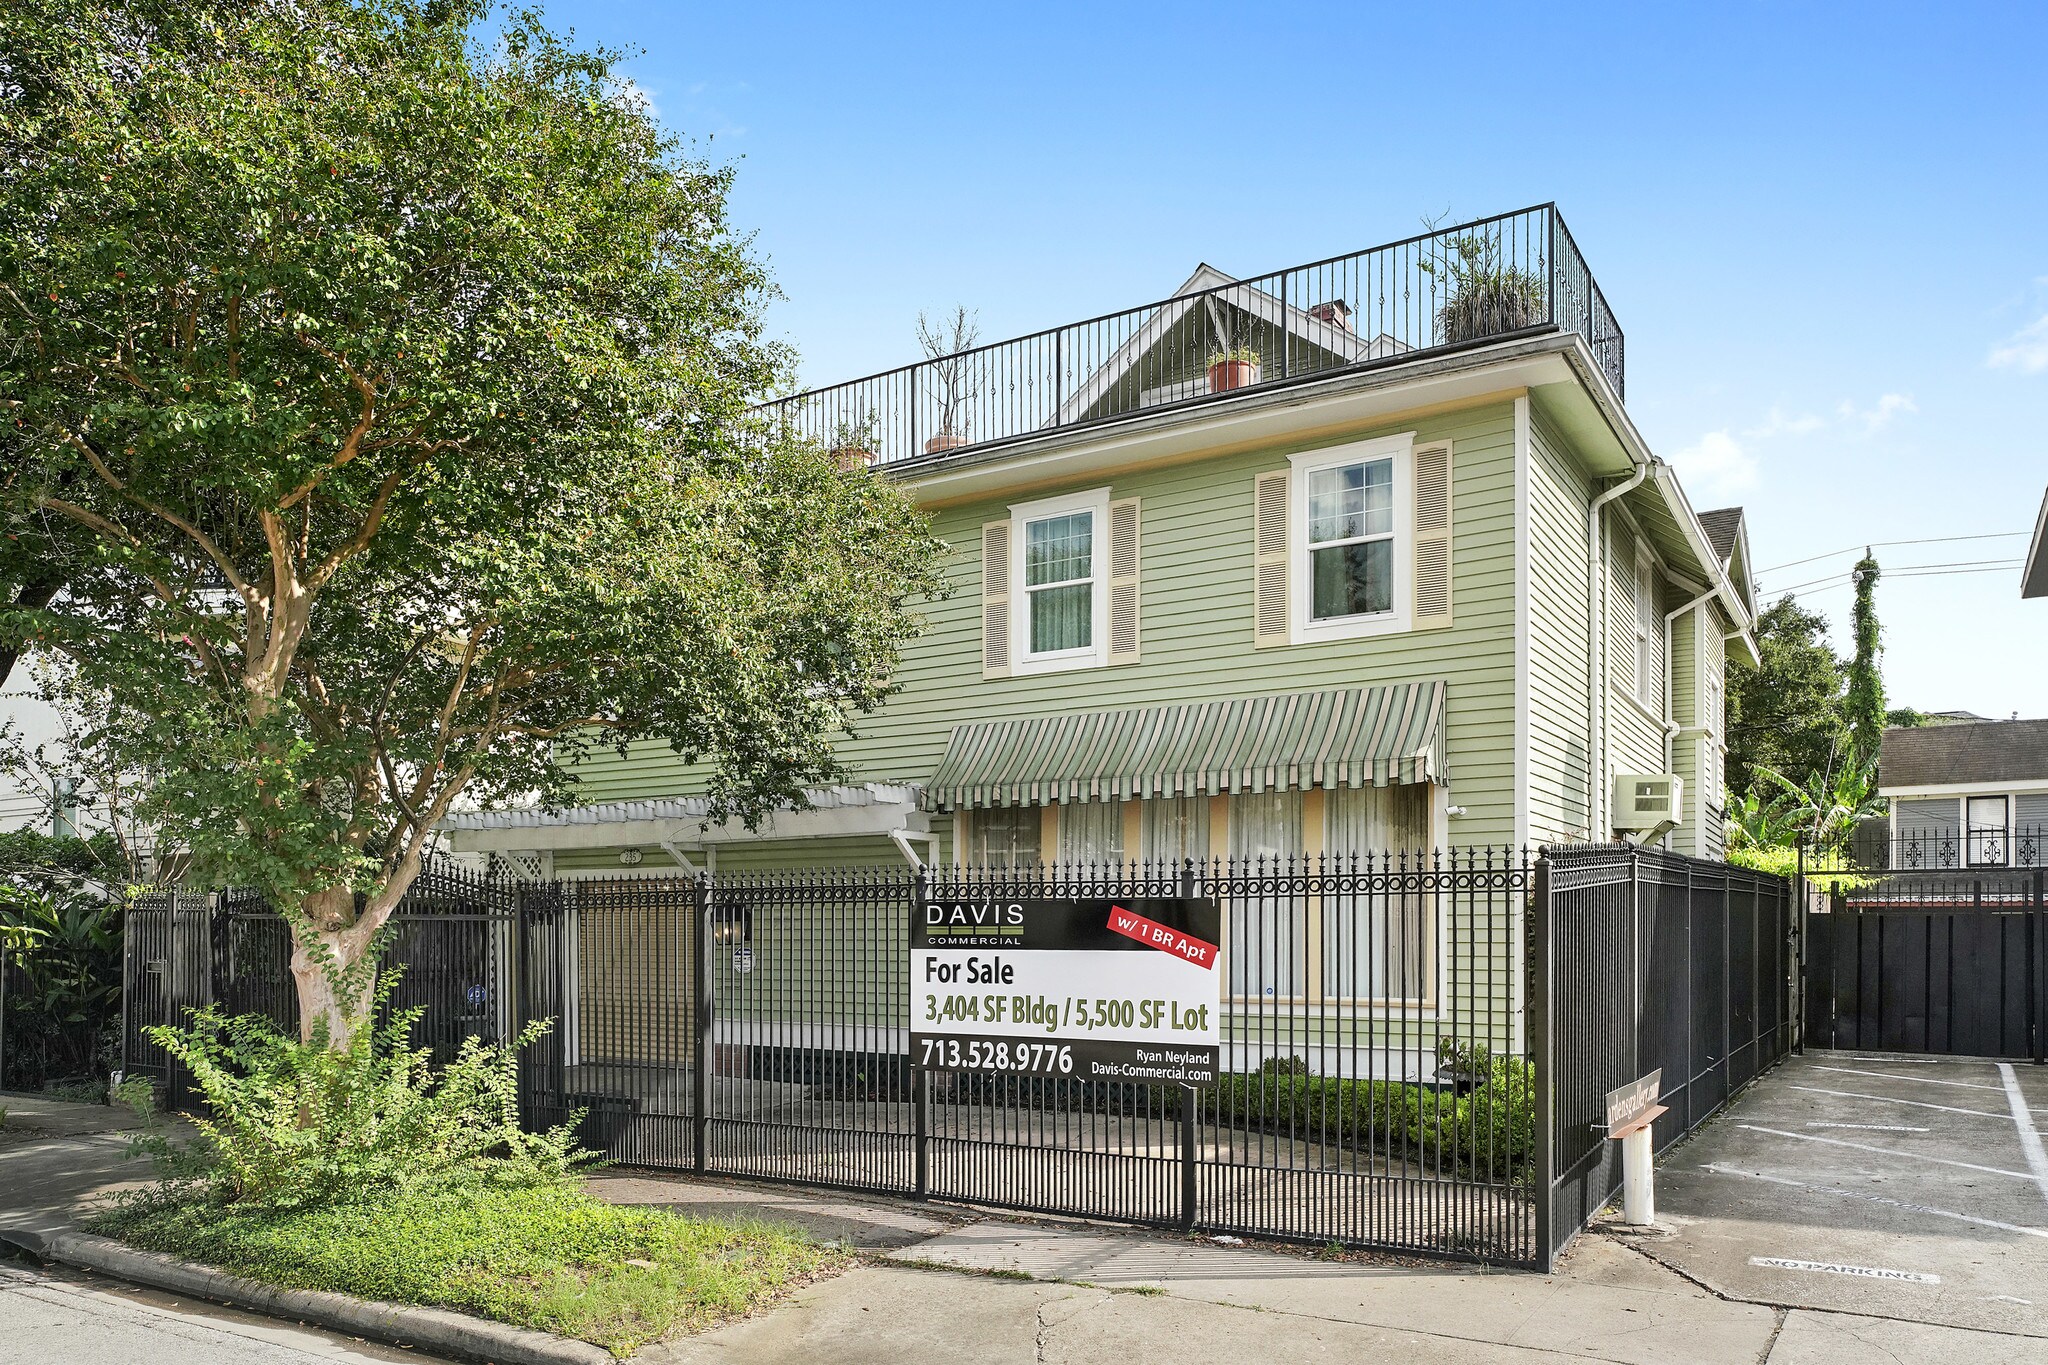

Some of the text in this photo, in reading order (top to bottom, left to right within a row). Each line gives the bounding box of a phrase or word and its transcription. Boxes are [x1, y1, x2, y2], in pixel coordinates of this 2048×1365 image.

[926, 903, 1024, 925] DAVIS
[928, 936, 1021, 945] COMMERCIAL
[1117, 917, 1207, 961] w/ 1 BR Apt
[926, 956, 1014, 985] For Sale
[925, 994, 1209, 1033] 3,404 SF Bldg / 5,500 SF Lot
[921, 1039, 1073, 1074] 713.528.9776
[1136, 1049, 1210, 1068] Ryan Neyland
[1091, 1062, 1212, 1082] Davis-Commercial.com
[1765, 1259, 1922, 1281] NO PARKING
